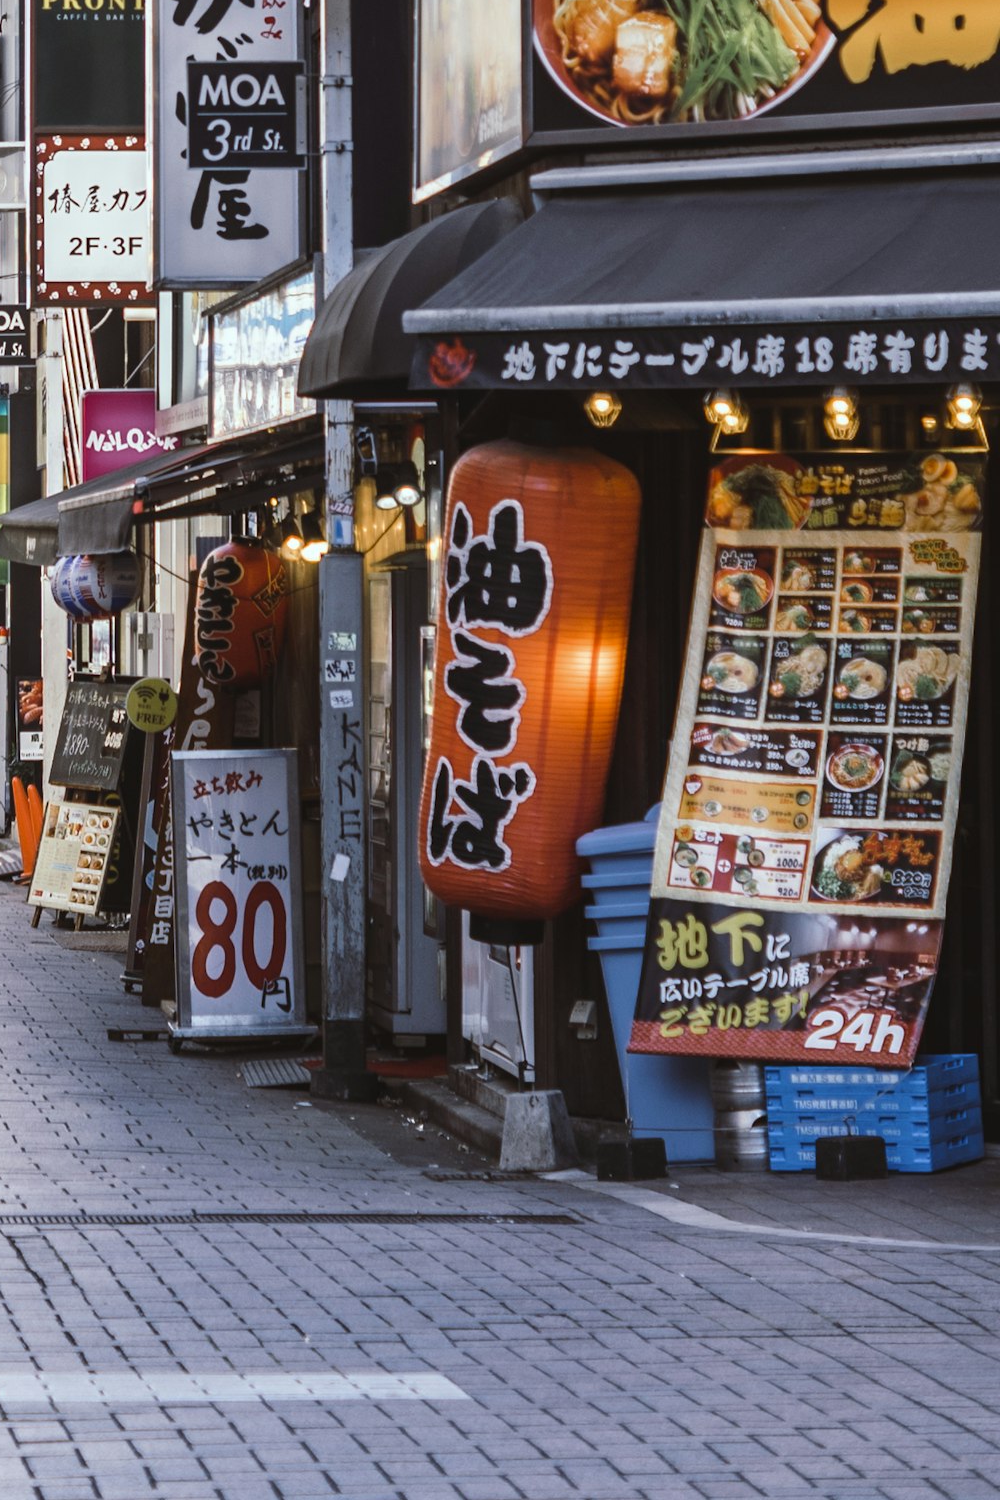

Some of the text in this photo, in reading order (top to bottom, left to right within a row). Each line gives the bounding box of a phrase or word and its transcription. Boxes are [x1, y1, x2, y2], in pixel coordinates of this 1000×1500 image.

[199, 74, 285, 107] MOA
[202, 120, 284, 162] 3rd St.
[12, 344, 24, 357] St.
[502, 329, 1000, 382] 地下にテーブル席18席有りま
[426, 499, 555, 873] 油そば
[137, 713, 166, 725] FREE
[191, 770, 263, 800] 立ち飲み
[186, 809, 289, 841] やきとん
[187, 843, 248, 877] 一本
[656, 911, 792, 971] 地下に
[659, 962, 810, 1004] 広いテーブル席
[803, 1008, 906, 1055] 24h
